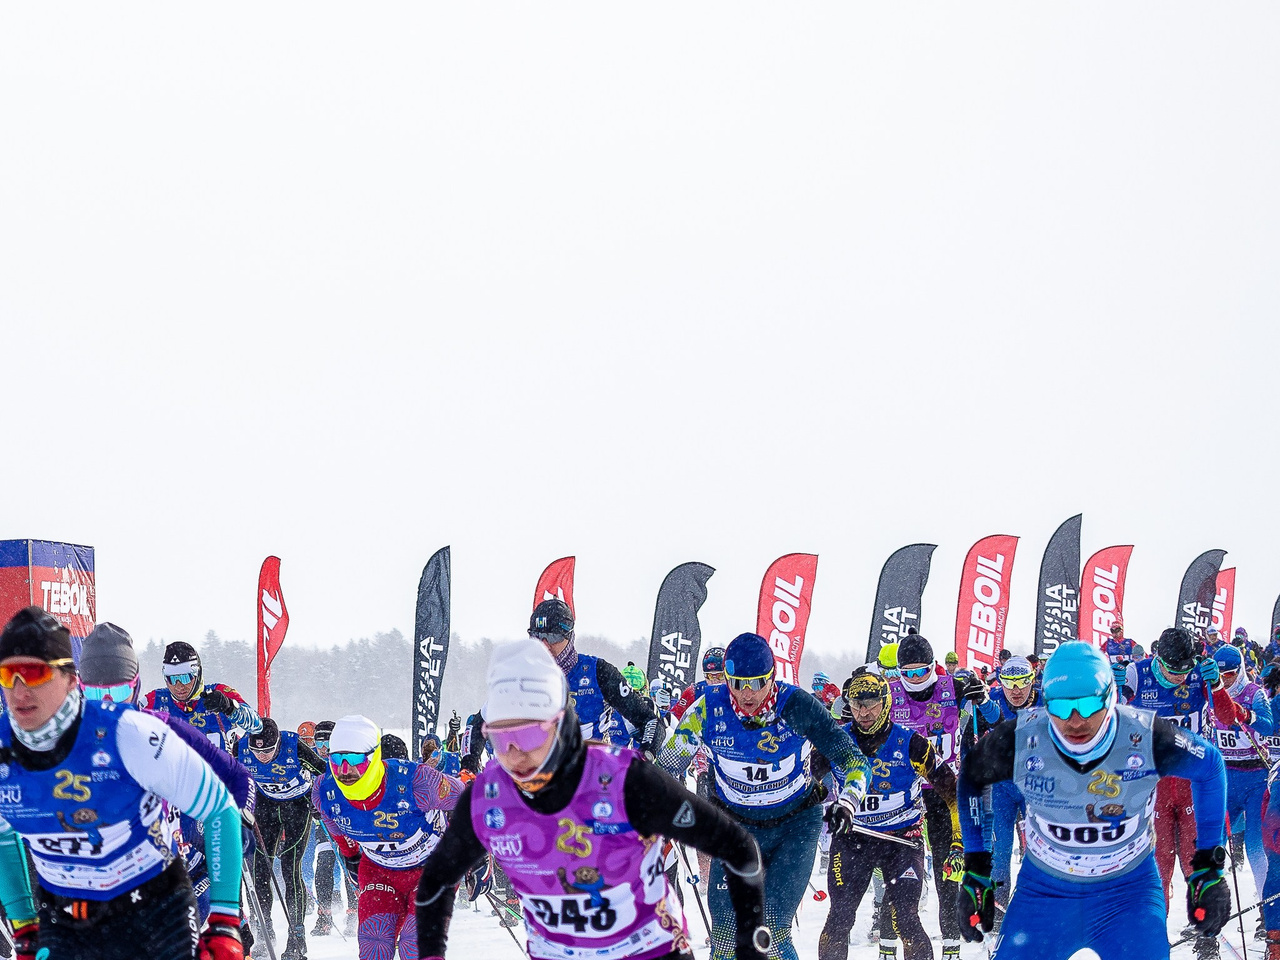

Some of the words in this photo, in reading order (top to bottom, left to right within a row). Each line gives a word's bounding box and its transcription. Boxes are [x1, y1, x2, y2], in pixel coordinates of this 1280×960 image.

[772, 574, 804, 685] EBOIL
[1042, 583, 1063, 654] USSIA
[757, 731, 779, 753] 25
[1220, 732, 1237, 747] 56
[742, 766, 769, 782] 14
[871, 758, 891, 778] 25
[54, 770, 92, 802] 25
[1087, 770, 1122, 798] 25
[374, 811, 399, 829] 25
[556, 818, 594, 858] 25
[833, 852, 844, 886] TriSport
